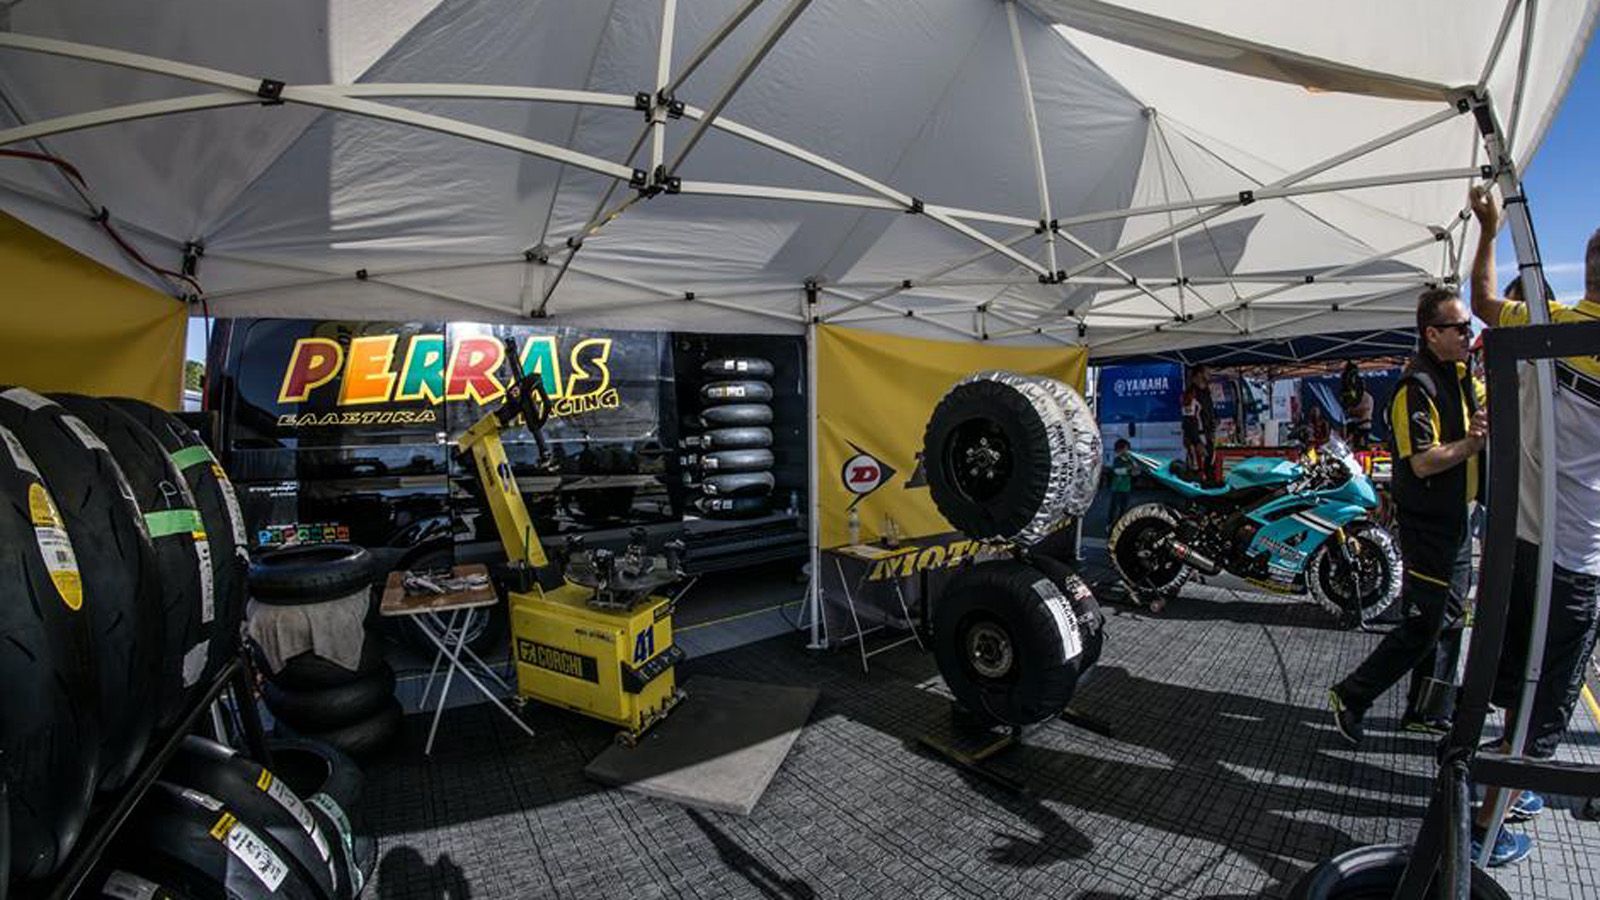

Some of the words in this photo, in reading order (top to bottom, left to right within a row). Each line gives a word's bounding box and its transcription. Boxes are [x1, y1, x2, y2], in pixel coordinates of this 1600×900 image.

[277, 334, 612, 406] PERRAS
[1126, 377, 1169, 391] YAMAHA
[537, 645, 583, 678] CORGHI
[633, 624, 655, 663] 41
